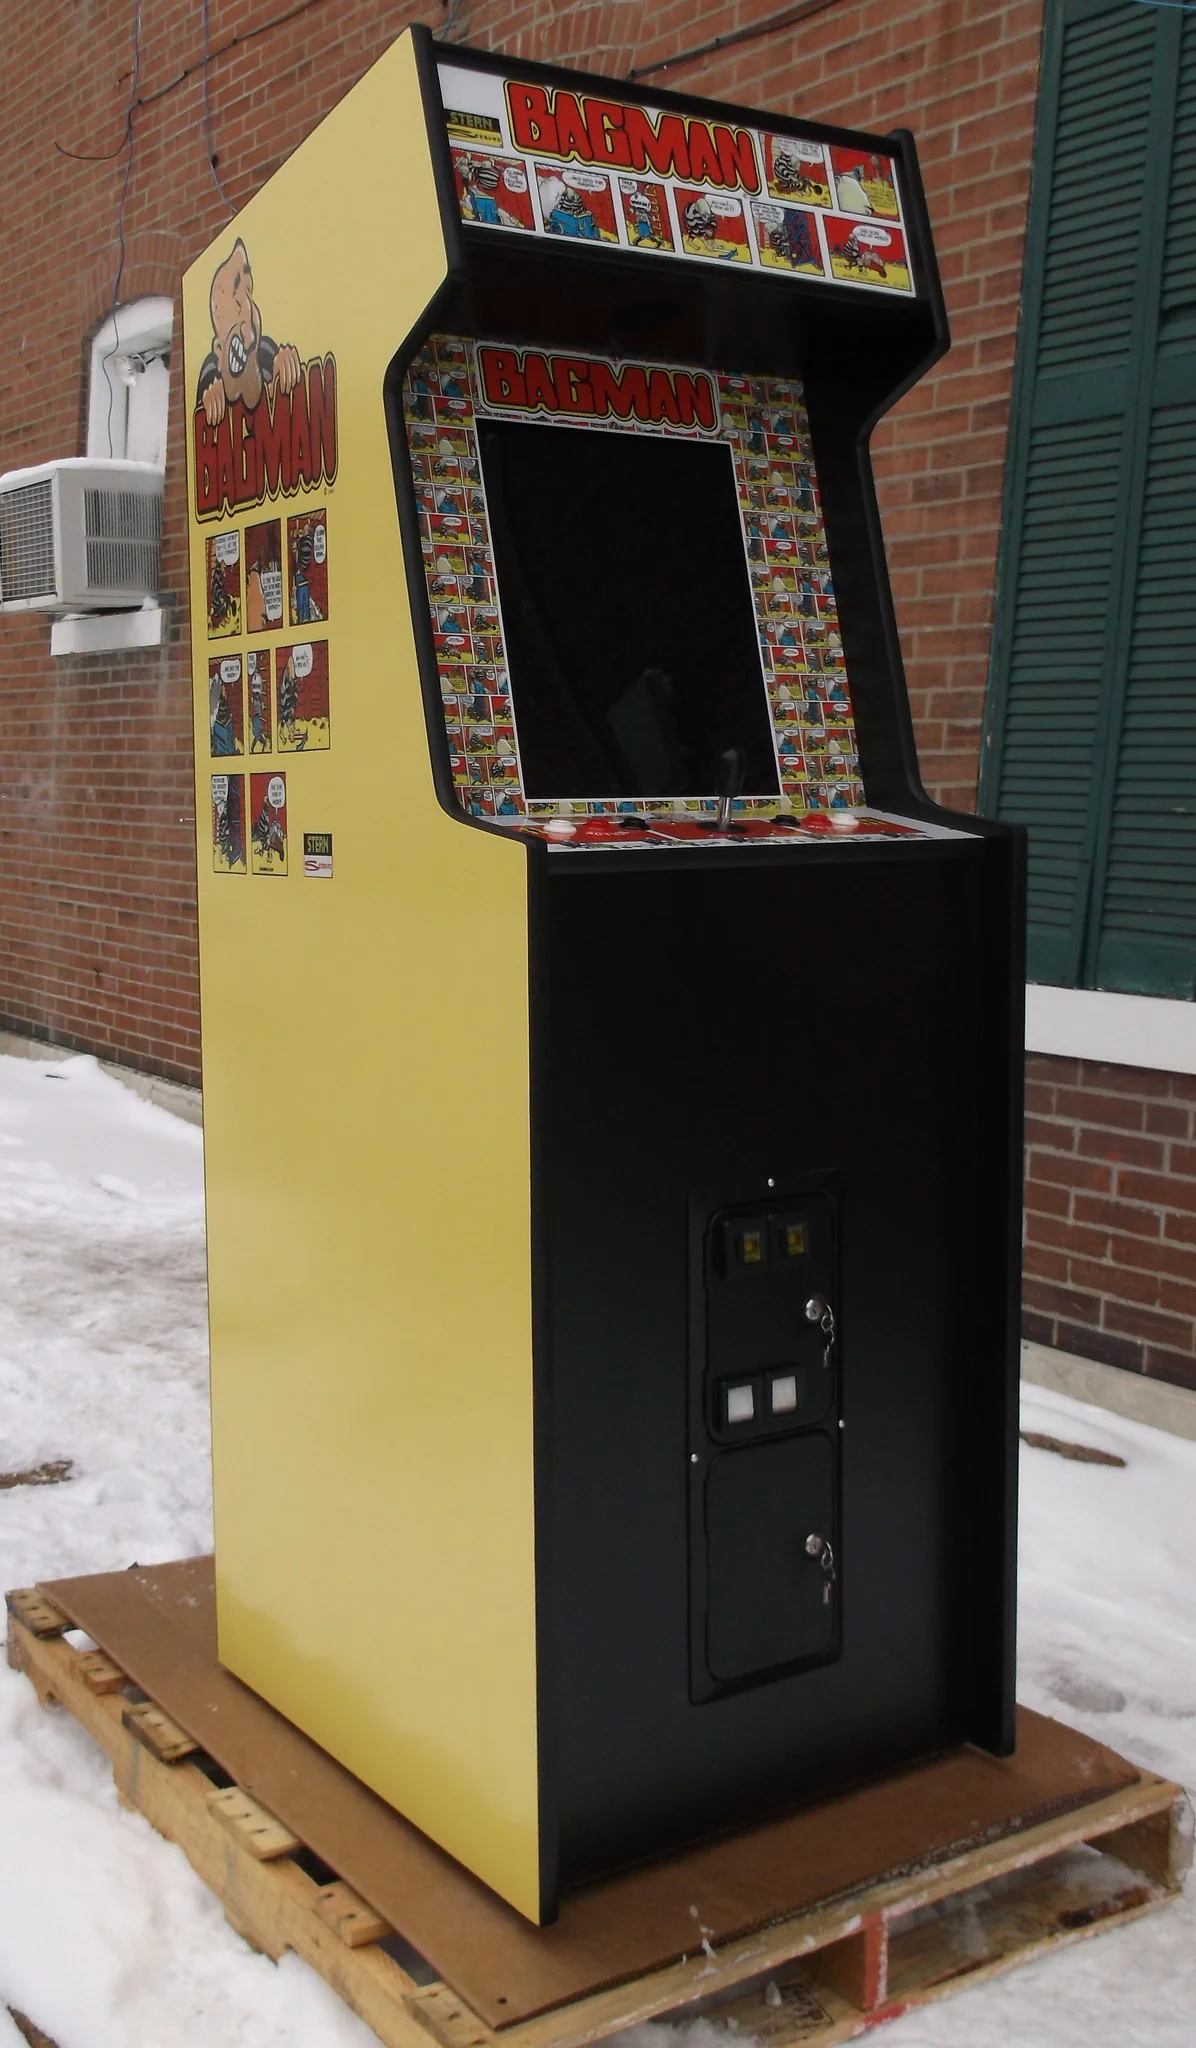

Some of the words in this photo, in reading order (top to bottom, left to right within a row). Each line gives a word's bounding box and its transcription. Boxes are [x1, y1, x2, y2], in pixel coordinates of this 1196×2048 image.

[450, 112, 493, 129] STERN
[504, 81, 761, 195] BAGMAN
[478, 346, 718, 431] BAGMAN
[194, 352, 339, 523] BAGMAN
[307, 836, 329, 853] STERN
